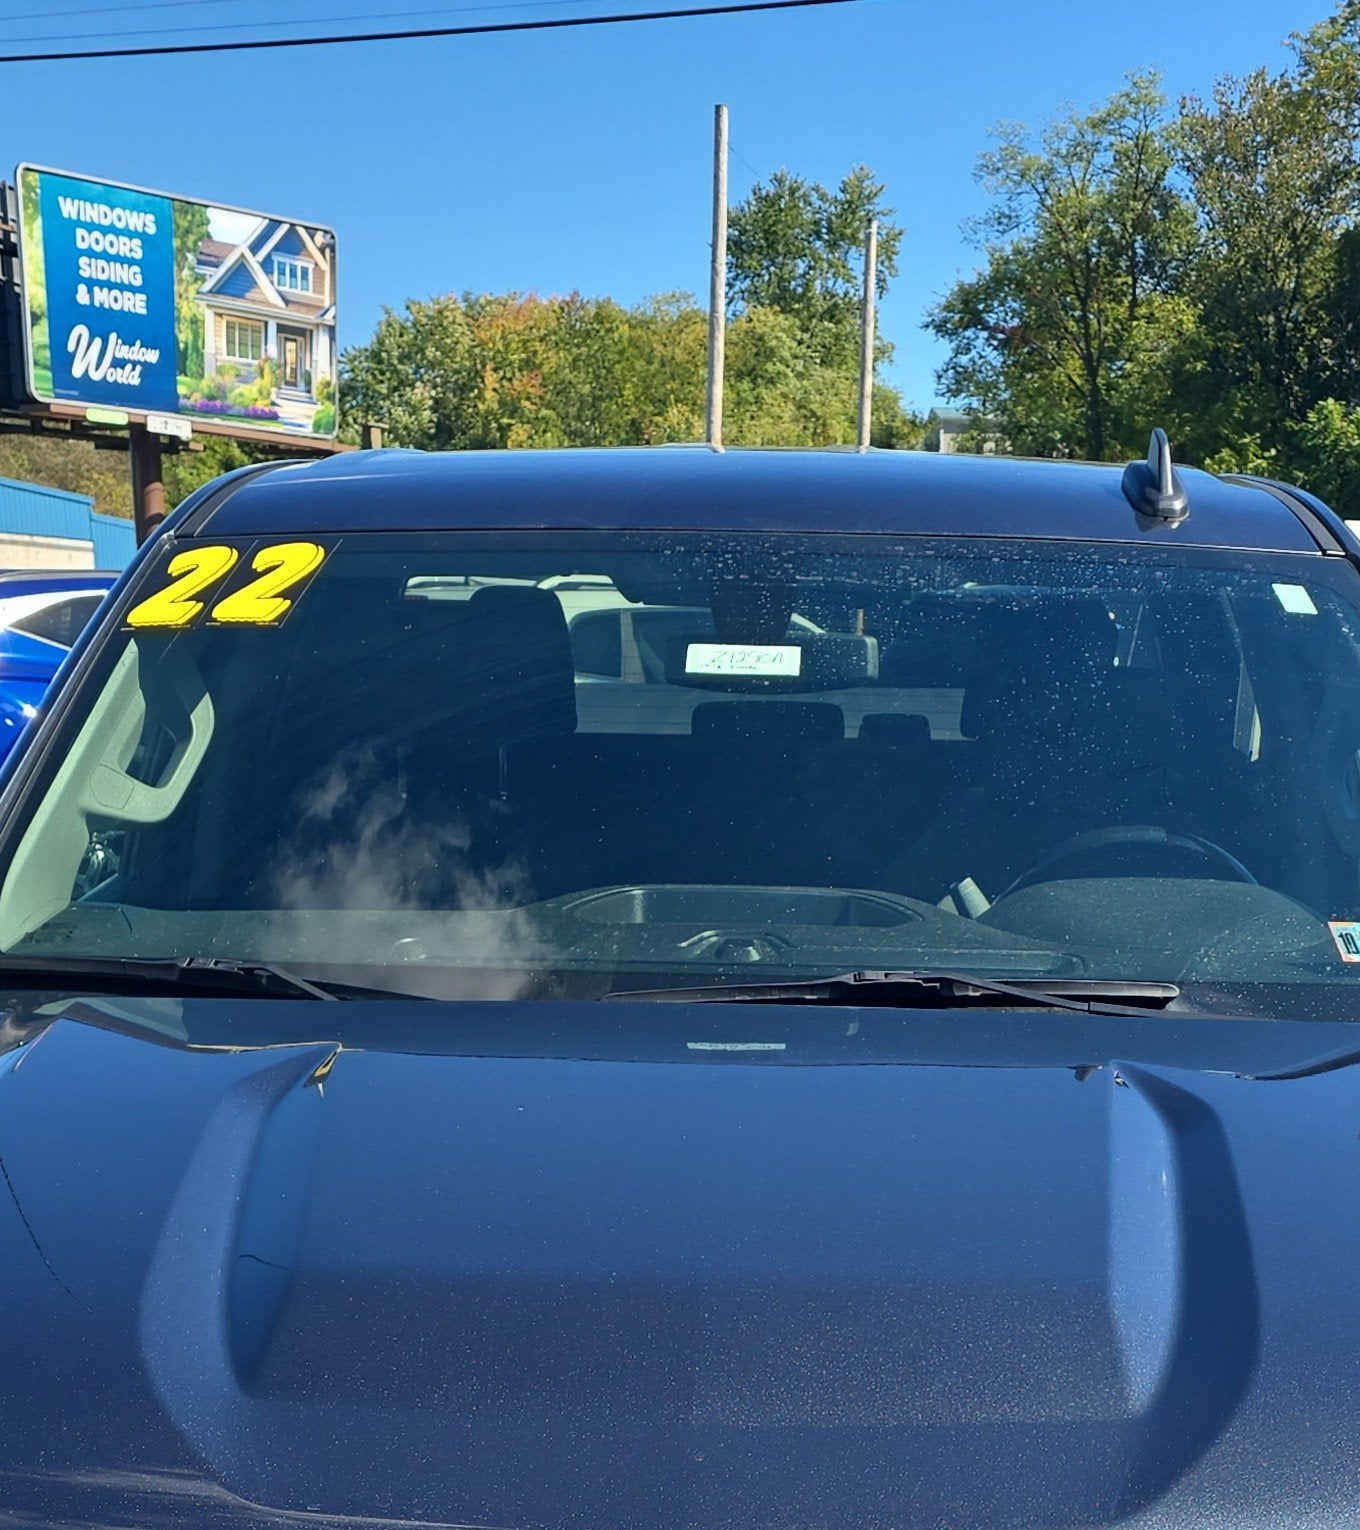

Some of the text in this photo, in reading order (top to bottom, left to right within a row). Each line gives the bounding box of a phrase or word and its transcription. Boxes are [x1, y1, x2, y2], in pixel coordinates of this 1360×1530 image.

[57, 195, 157, 235] WINDOWS
[75, 227, 143, 259] DOORS
[78, 256, 143, 287] SIDING
[75, 283, 147, 315] & MORE
[67, 324, 160, 381] Window
[126, 541, 326, 627] 22
